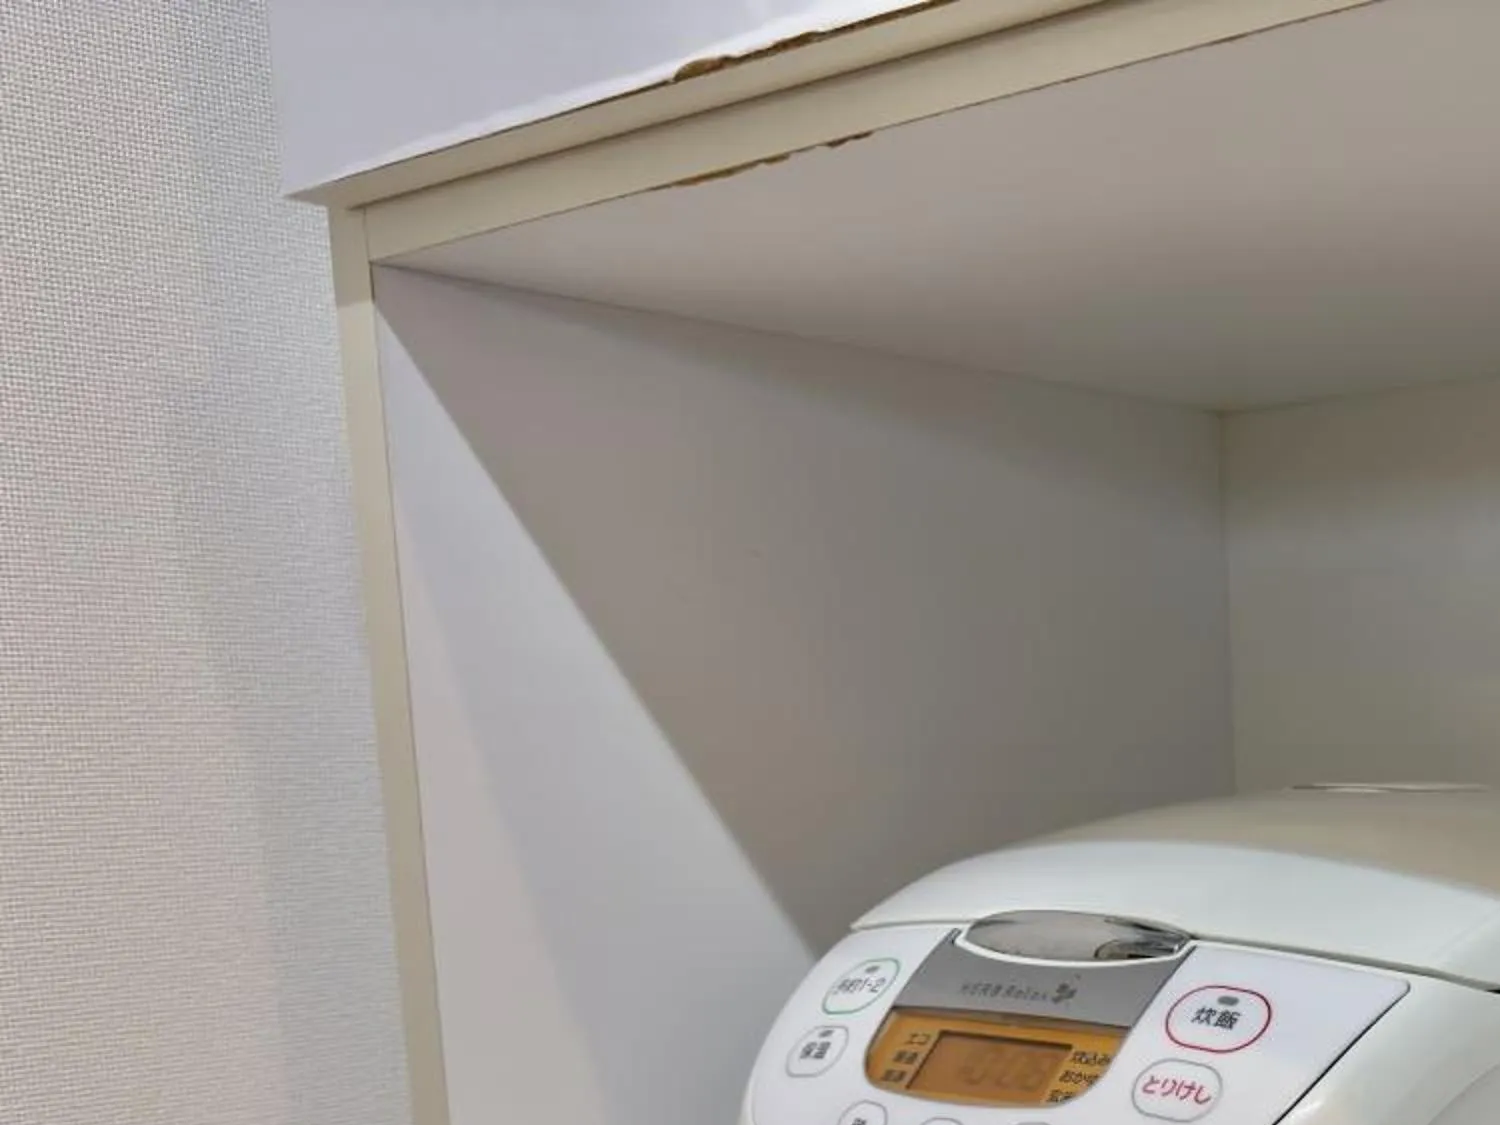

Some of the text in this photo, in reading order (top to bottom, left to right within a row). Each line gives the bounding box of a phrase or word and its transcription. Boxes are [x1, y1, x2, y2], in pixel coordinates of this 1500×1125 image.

[1191, 1006, 1242, 1030] 炊飯
[1142, 1075, 1212, 1105] とりけし
